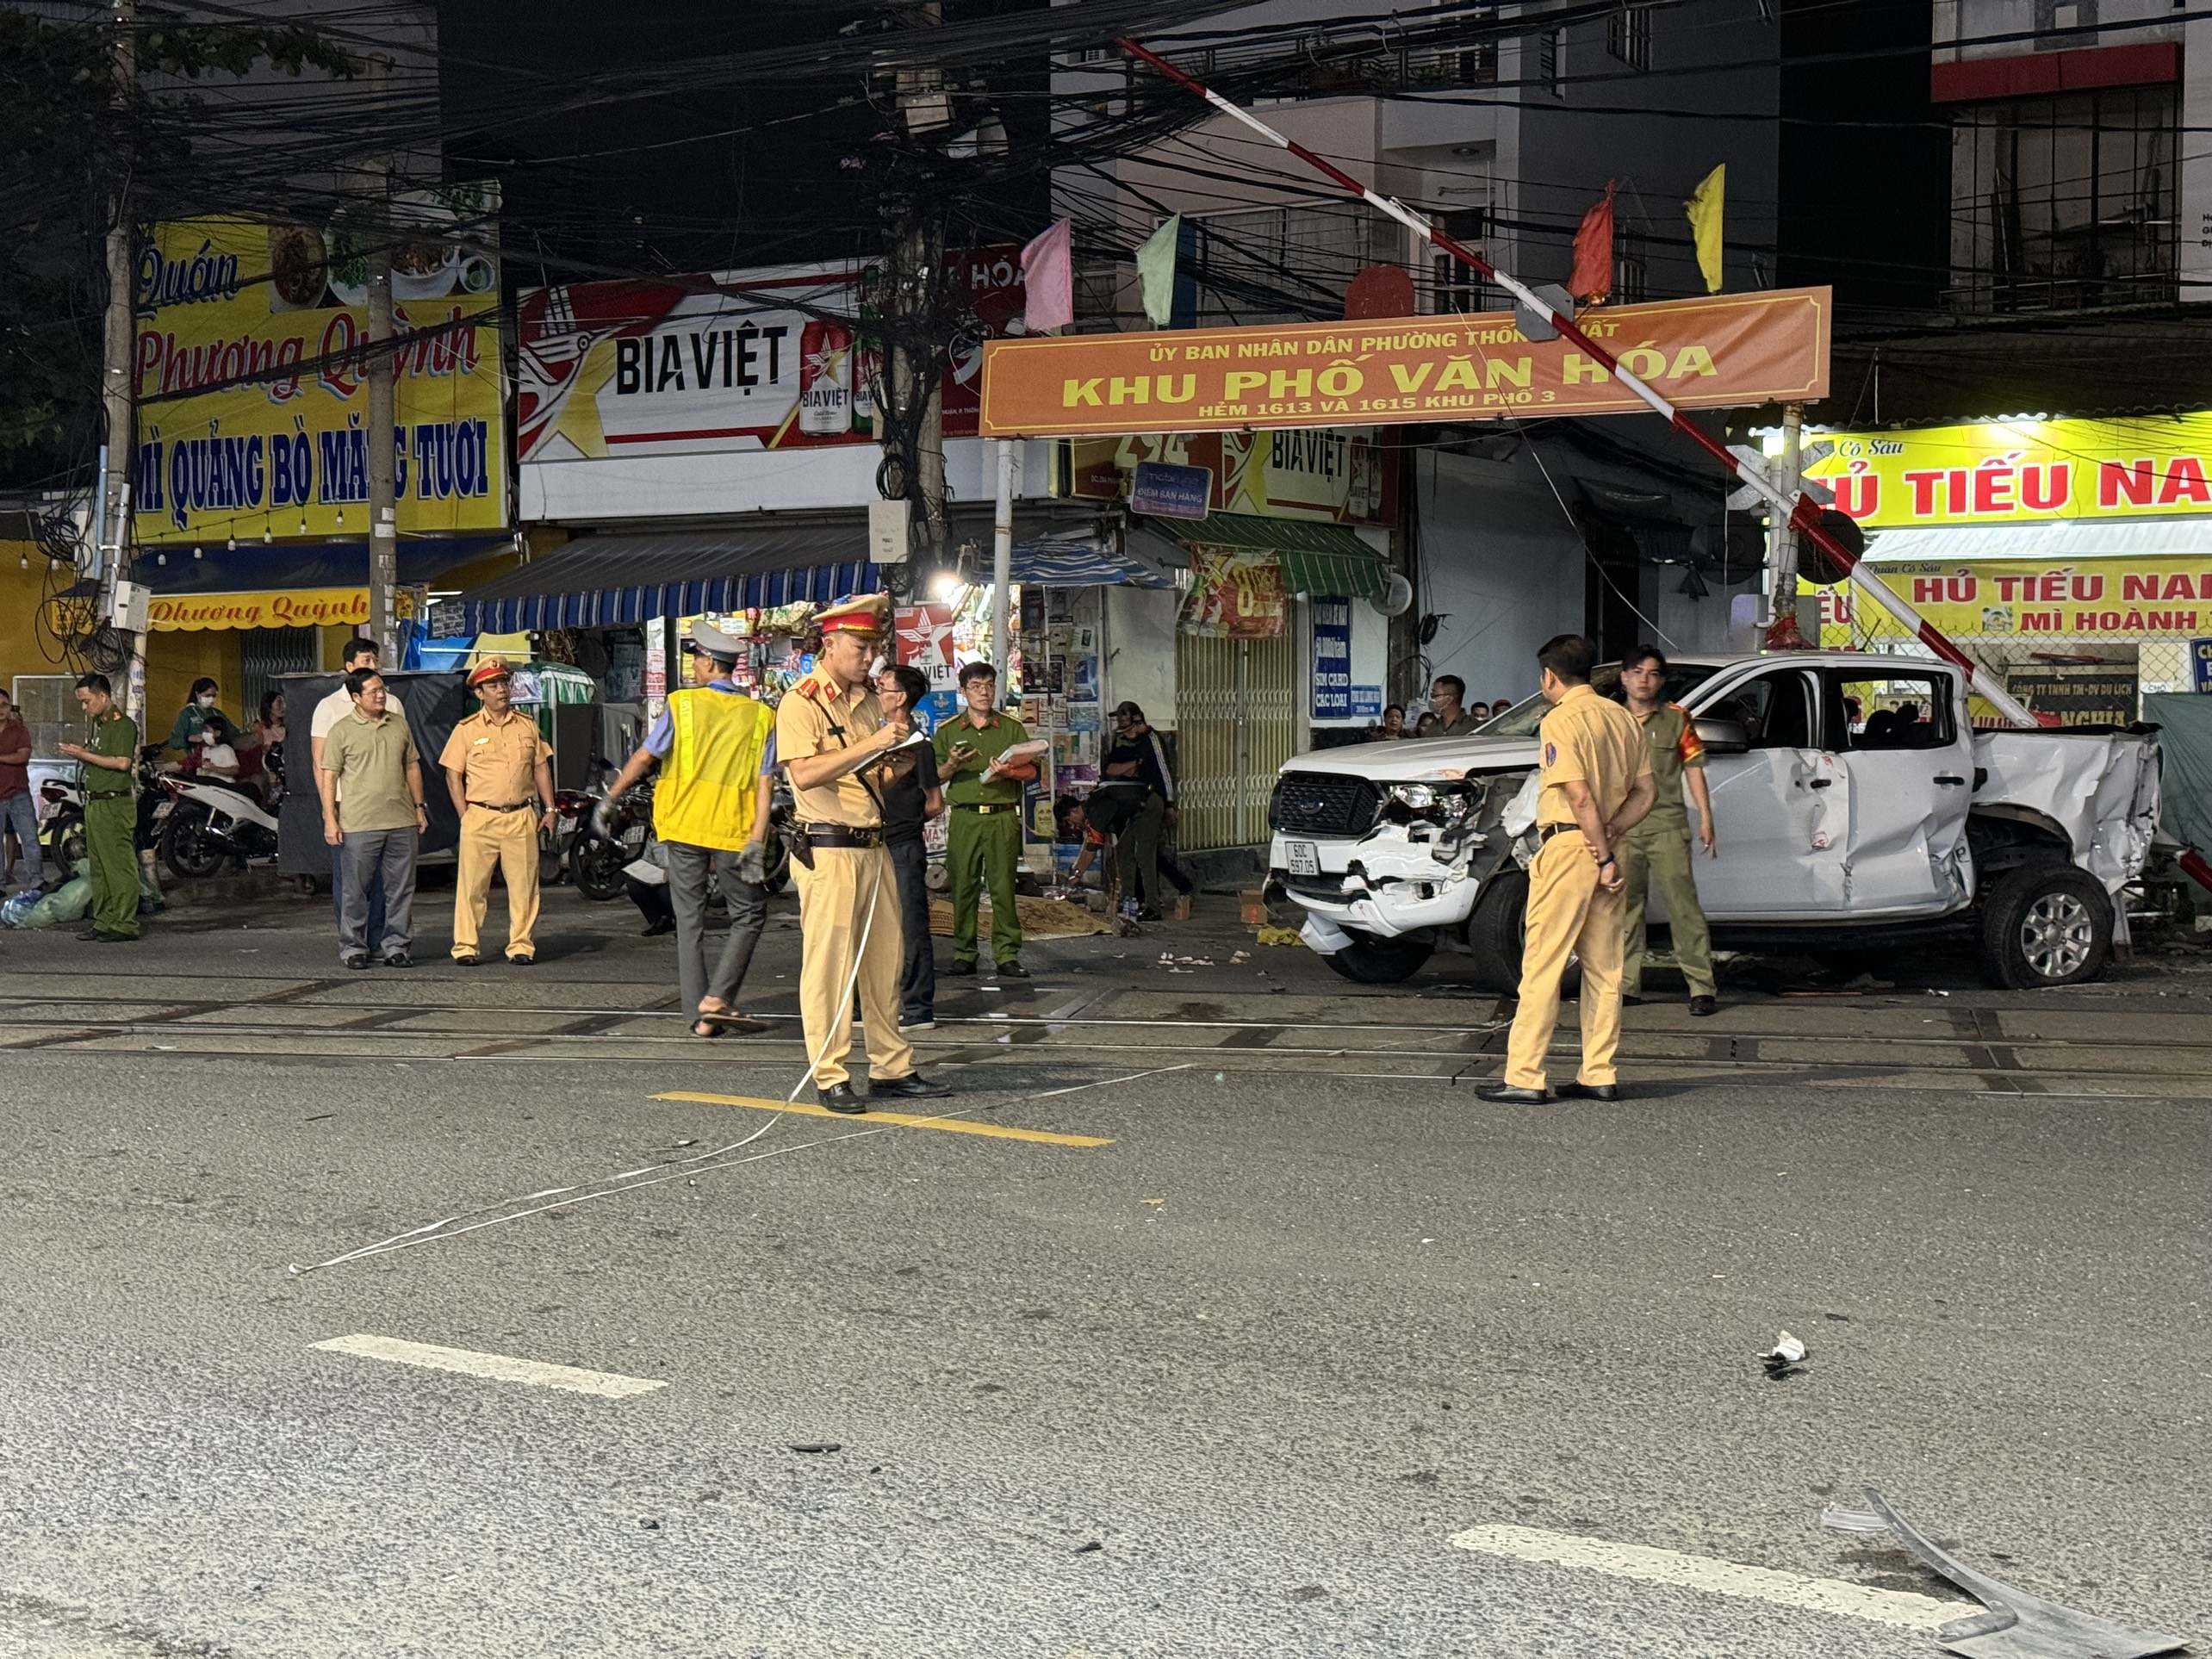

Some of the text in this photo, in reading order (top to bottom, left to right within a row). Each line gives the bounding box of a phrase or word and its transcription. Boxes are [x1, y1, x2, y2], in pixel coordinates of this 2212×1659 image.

[136, 239, 239, 319] Quán
[1150, 342, 1177, 362] ỦY
[1186, 345, 1230, 361] BAN
[1238, 338, 1299, 357] NHÂN
[1307, 333, 1353, 354] DÂN
[1361, 331, 1457, 352] PHƯỜNG
[1465, 323, 1528, 345] THỐN
[136, 332, 303, 403] Phương
[1063, 340, 1718, 407] KHU PHỐ VĂN HÓA
[1198, 386, 1556, 418] HẺM 1613 VÀ 1615 KHU PHỐ 3
[1840, 438, 1905, 457] Cô Sáu
[171, 419, 264, 529] QUẢNG
[270, 414, 313, 506] BÒ
[319, 411, 407, 505] MĂG
[414, 417, 489, 500] TƯƠI
[1904, 452, 2069, 515] TIẾU
[1913, 569, 1977, 603] HỦ
[1994, 567, 2103, 602] TIẾU
[151, 593, 368, 624] Phương Quỳnh
[2021, 607, 2197, 631] MÌ HOÀNH
[2036, 683, 2047, 696] TY
[1293, 844, 1308, 858] 60C
